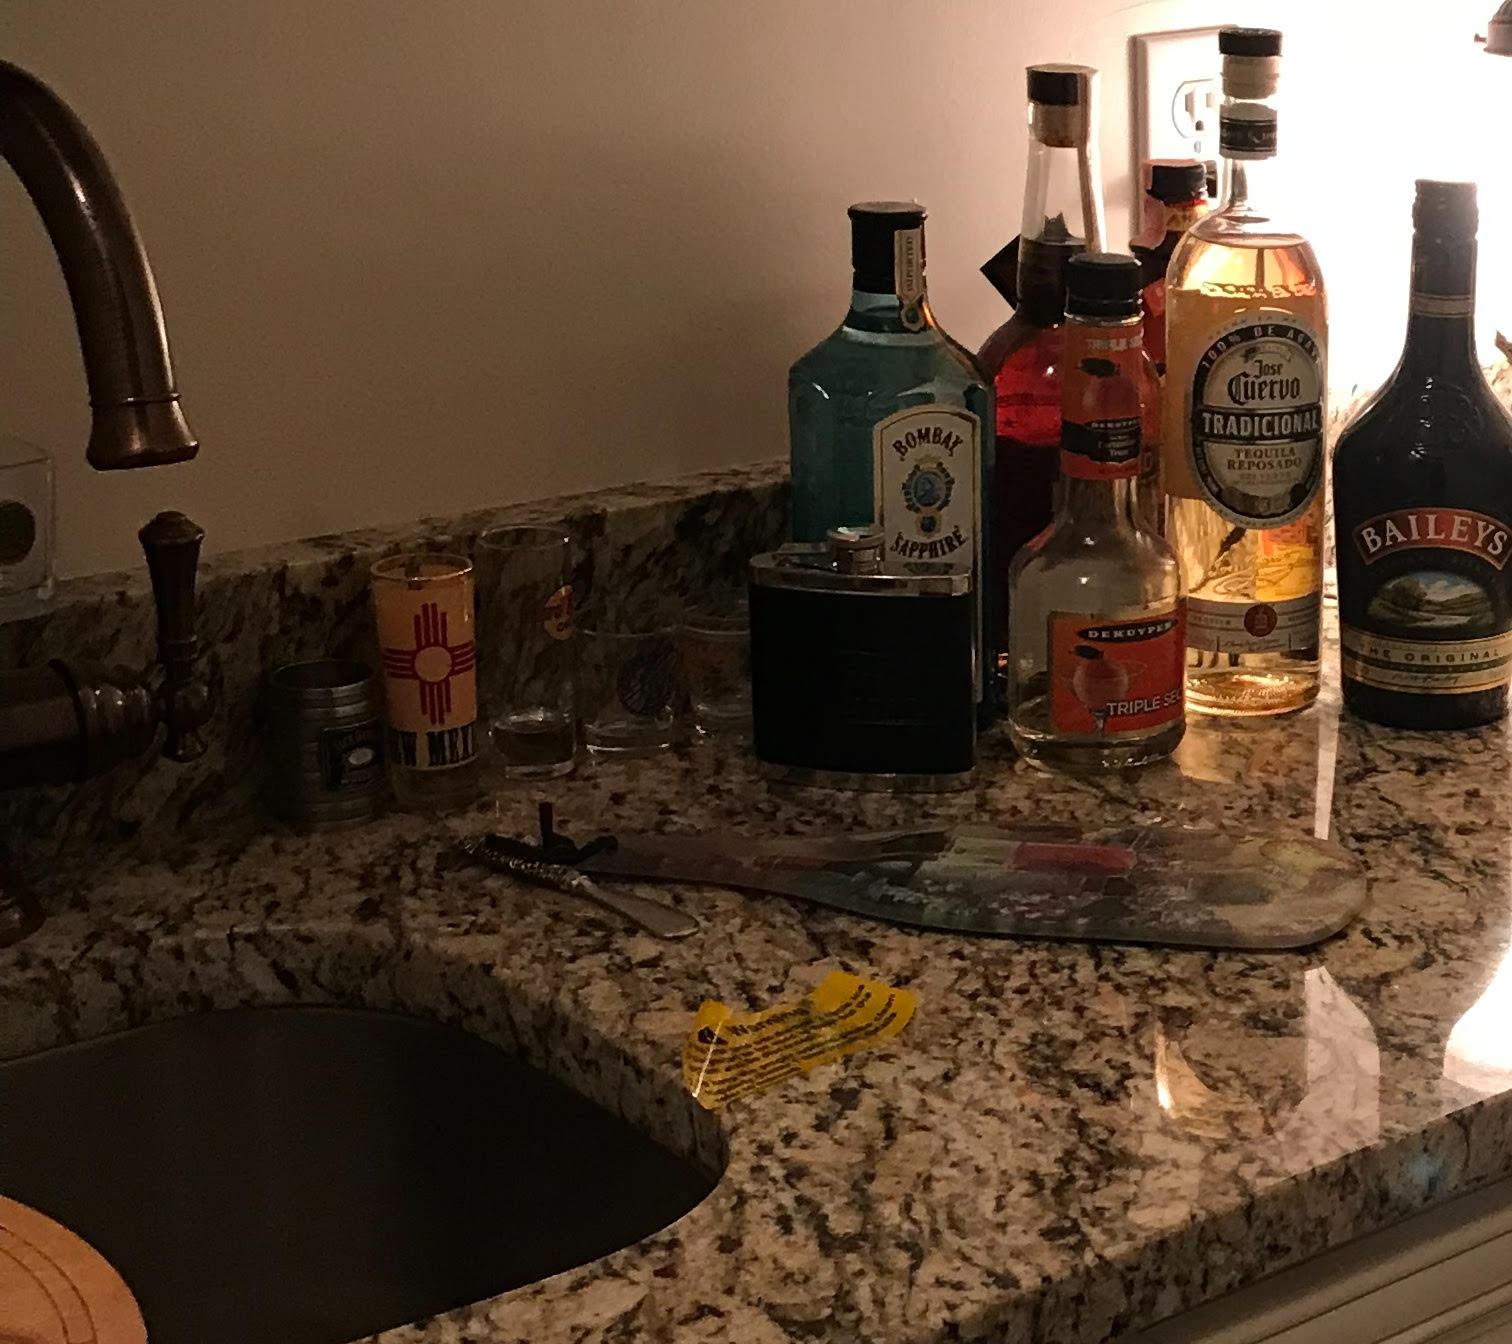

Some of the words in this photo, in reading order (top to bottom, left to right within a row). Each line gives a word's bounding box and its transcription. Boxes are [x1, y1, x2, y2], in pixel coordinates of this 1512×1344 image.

[1253, 359, 1283, 379] Jose
[1227, 371, 1301, 406] Cuervo
[1202, 408, 1319, 437] TRADICIONAL
[892, 426, 963, 461] BOMBAY
[1234, 447, 1296, 459] TEQUILA
[1227, 457, 1302, 471] REPOSADO
[890, 525, 967, 559] SAPPHIRE
[1360, 513, 1508, 555] BAILEYS
[1404, 649, 1499, 663] ORIGINAL
[1106, 696, 1161, 716] TRIPLE
